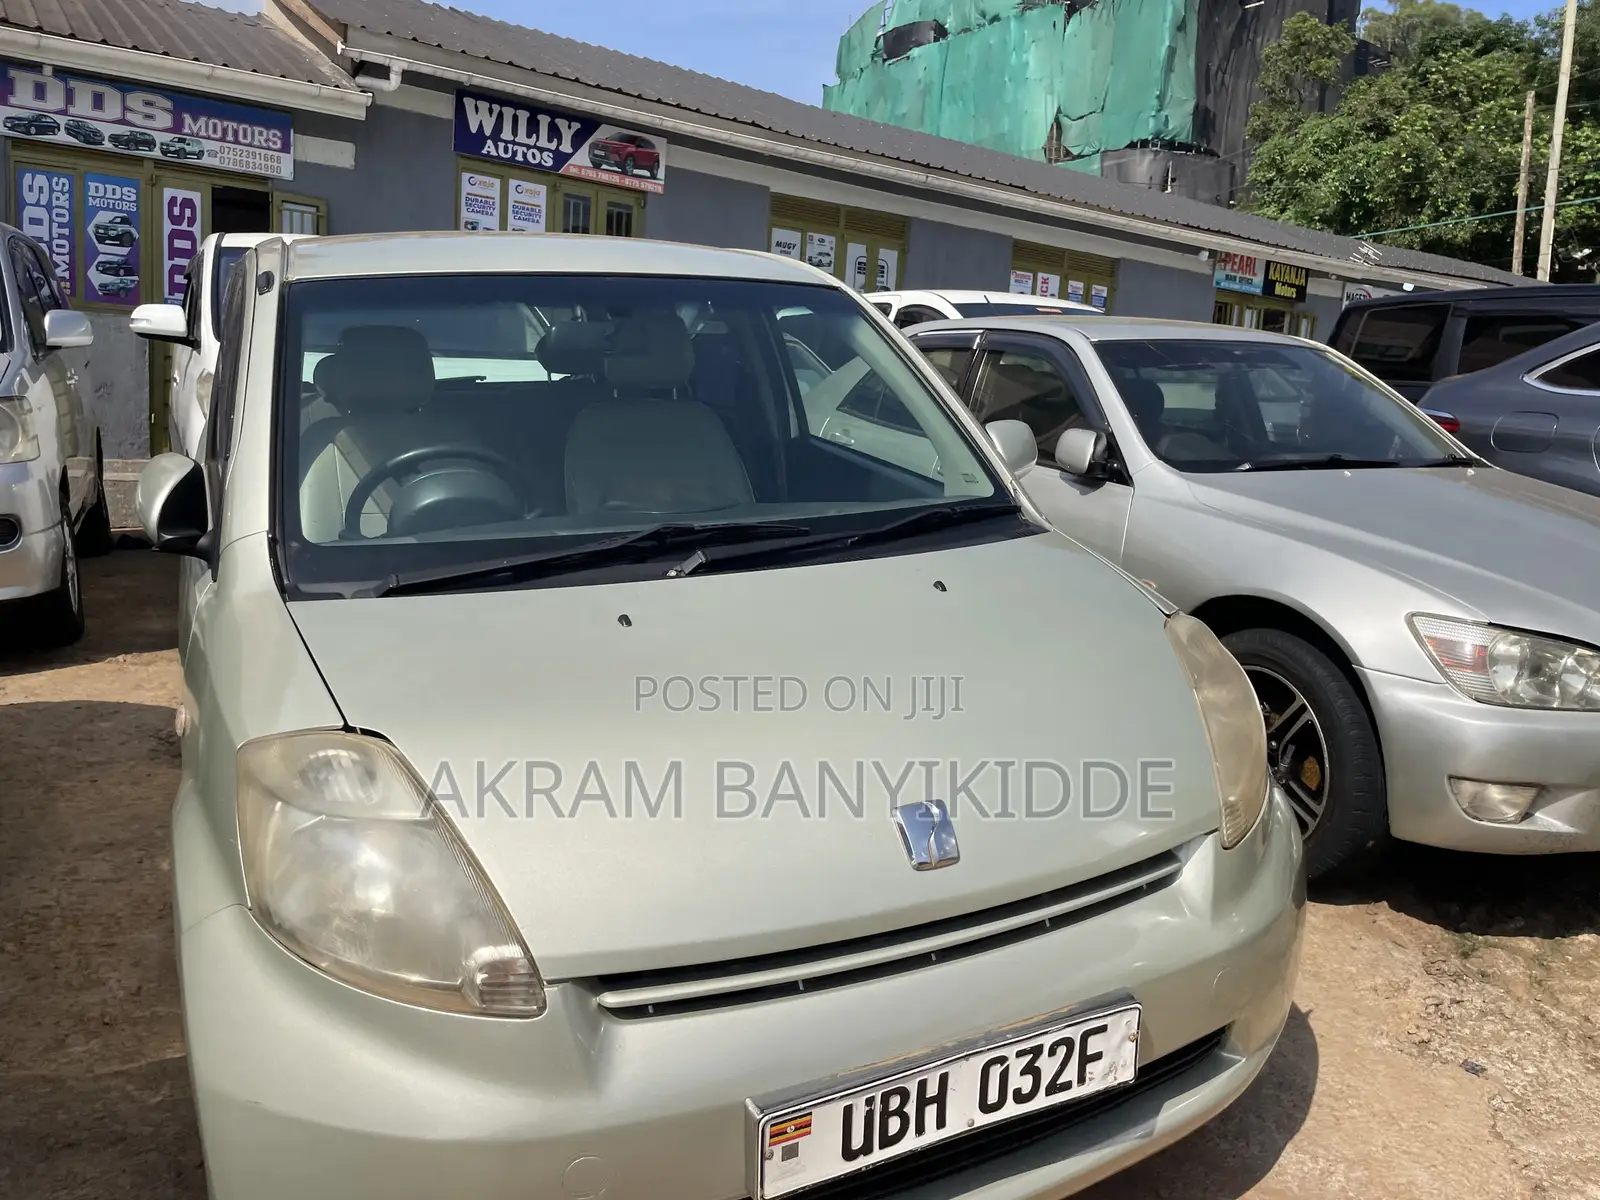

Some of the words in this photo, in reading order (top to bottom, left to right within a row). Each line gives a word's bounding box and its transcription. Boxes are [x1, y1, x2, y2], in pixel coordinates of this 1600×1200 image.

[7, 69, 173, 130] DDS
[182, 113, 282, 149] MOTORS
[463, 97, 581, 153] WILLY
[219, 146, 282, 164] 0752391668
[482, 140, 553, 167] AUTOS
[88, 182, 137, 201] DDS
[88, 196, 137, 212] MOTORS
[465, 196, 496, 207] DURABLE
[465, 202, 496, 212] SECURITY
[512, 204, 542, 214] DURABLE
[22, 172, 49, 257] DS
[466, 208, 494, 217] CAMERA
[512, 210, 542, 219] SECURITY
[513, 215, 540, 224] CAMERA
[52, 176, 70, 280] MOTORS
[1222, 251, 1257, 277] PEARL
[1268, 262, 1306, 287] KAYANJA
[1274, 281, 1297, 298] Motors
[840, 1071, 950, 1162] UBH
[977, 1023, 1109, 1115] 032F
